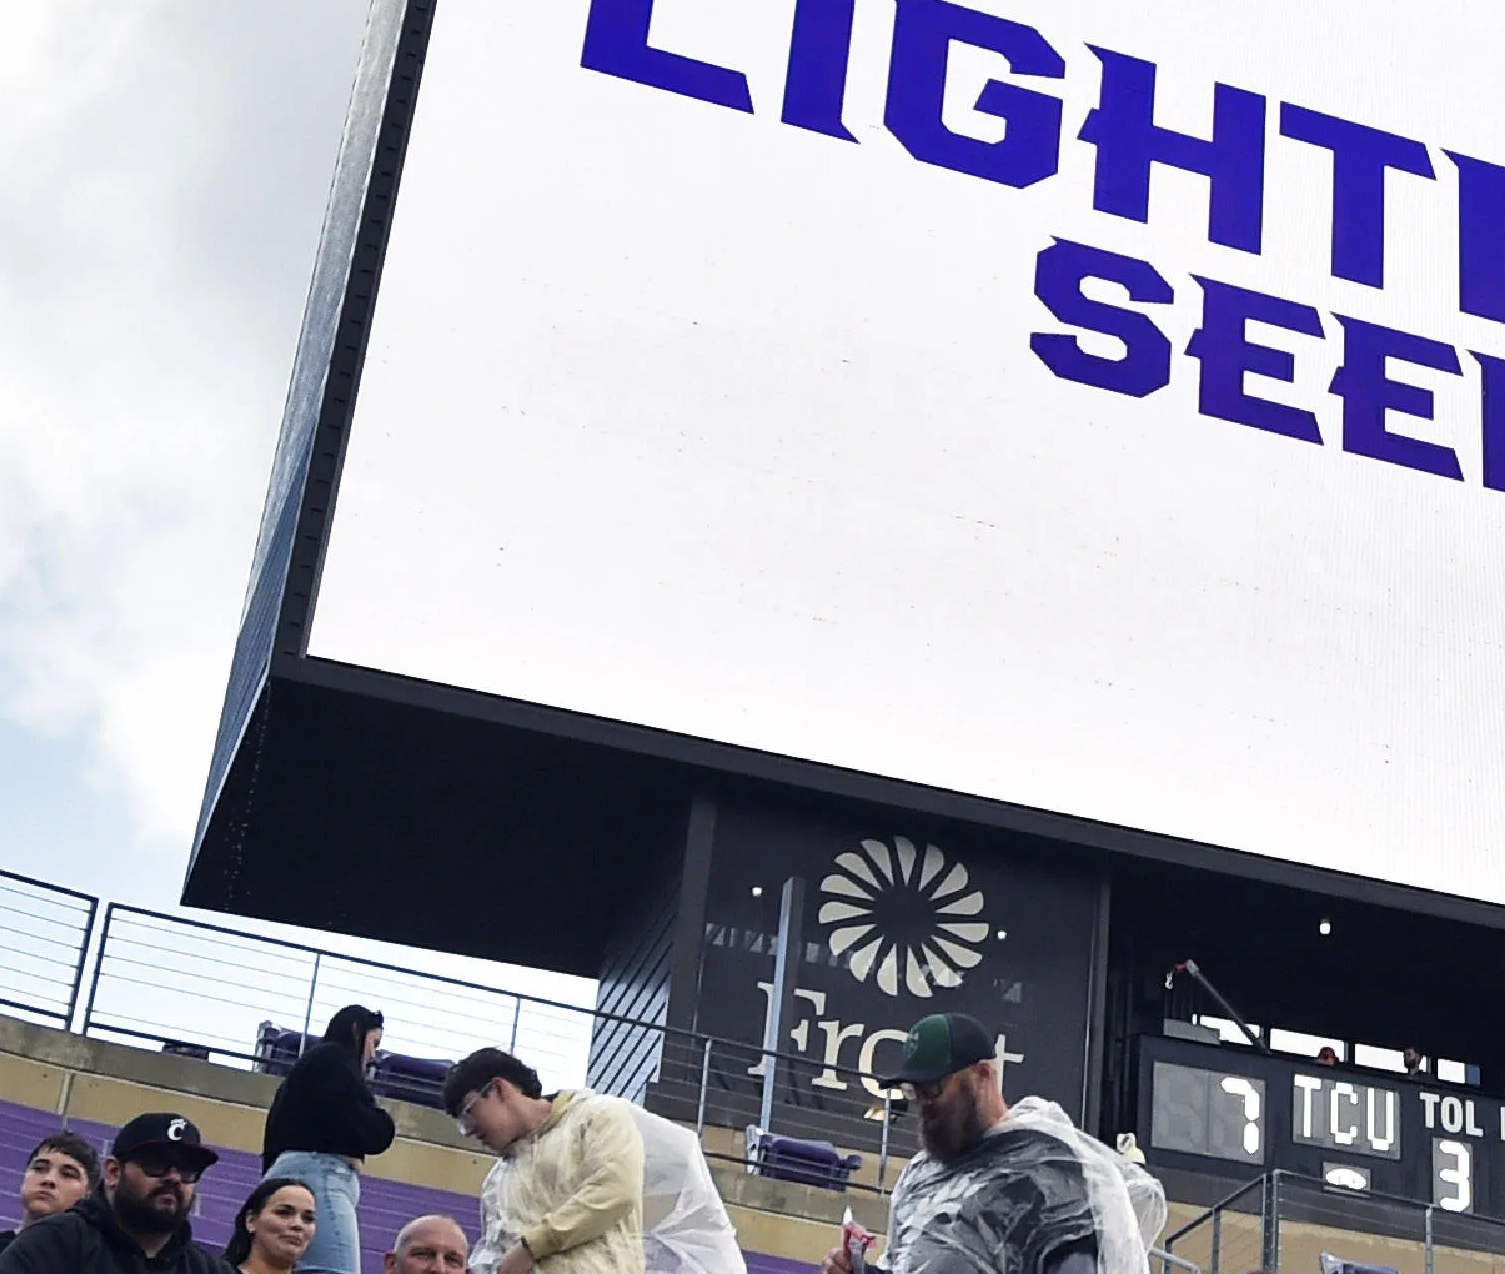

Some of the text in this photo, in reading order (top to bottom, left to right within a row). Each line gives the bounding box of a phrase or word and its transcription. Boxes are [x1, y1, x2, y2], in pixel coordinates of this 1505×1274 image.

[748, 982, 1024, 1100] Frot
[1221, 1077, 1260, 1154] 7
[1294, 1074, 1395, 1151] TCU
[1419, 1092, 1483, 1137] TOL
[1439, 1140, 1470, 1212] 3
